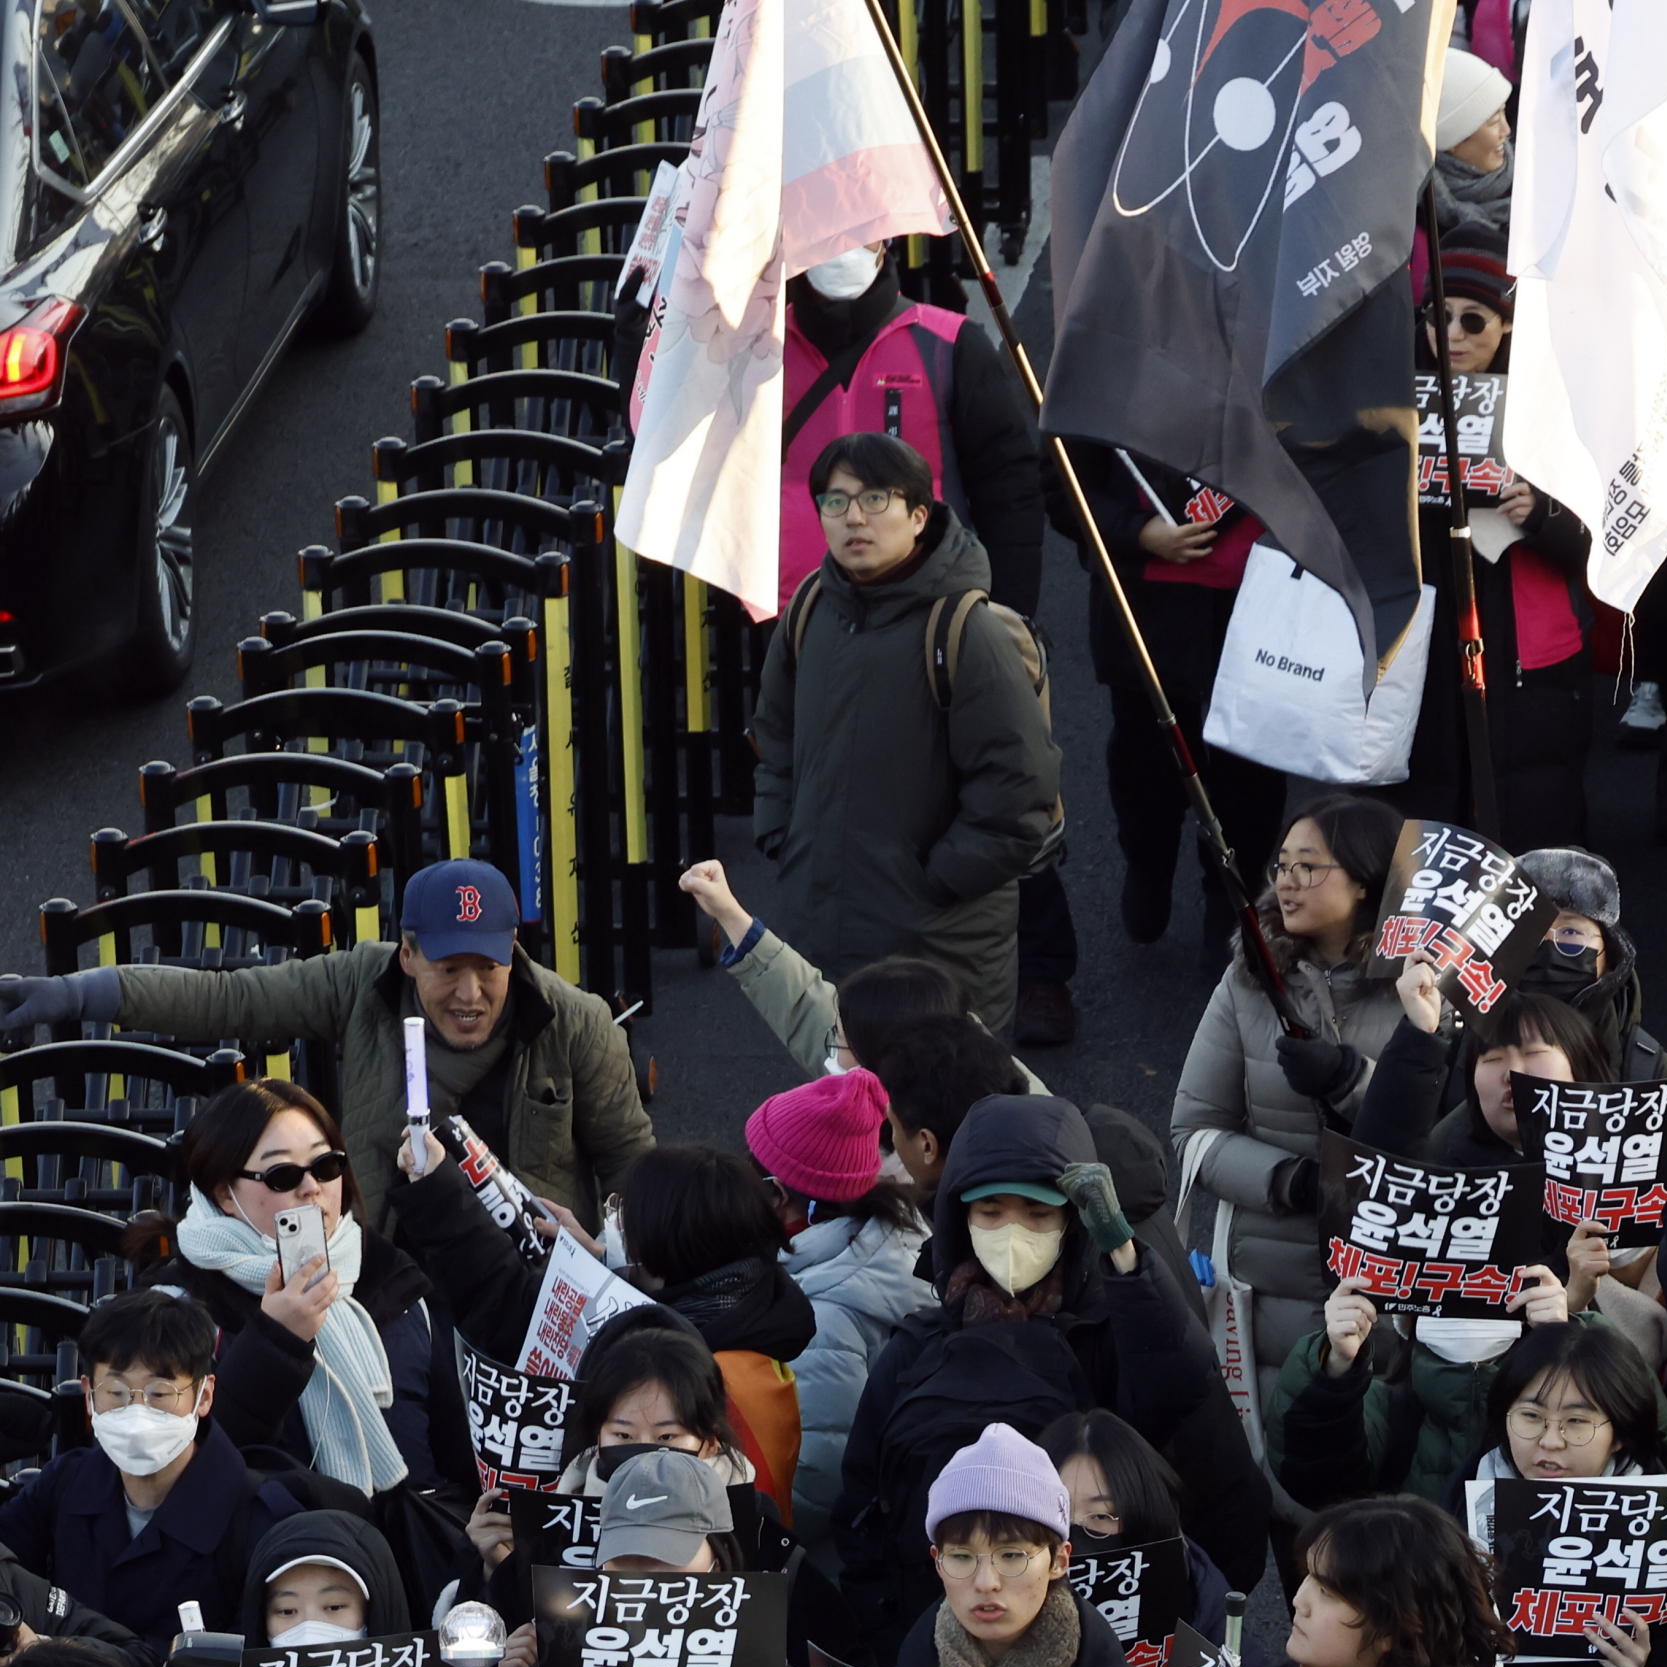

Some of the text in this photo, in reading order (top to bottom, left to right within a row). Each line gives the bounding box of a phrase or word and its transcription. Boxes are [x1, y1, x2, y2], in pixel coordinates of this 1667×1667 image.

[1255, 648, 1325, 684] No Brand
[1411, 826, 1539, 923] 지금당장
[1398, 867, 1518, 959] 윤석열
[1376, 914, 1509, 1016] 체포!구속!
[1344, 1152, 1514, 1218] 지금당장
[1543, 1131, 1662, 1184] 윤석열
[1348, 1198, 1501, 1263] 윤석열
[1326, 1235, 1528, 1304] 체포!구속!
[461, 1353, 577, 1427] 지금당장
[467, 1405, 565, 1471] 윤석열
[564, 1576, 751, 1628] 지금당장
